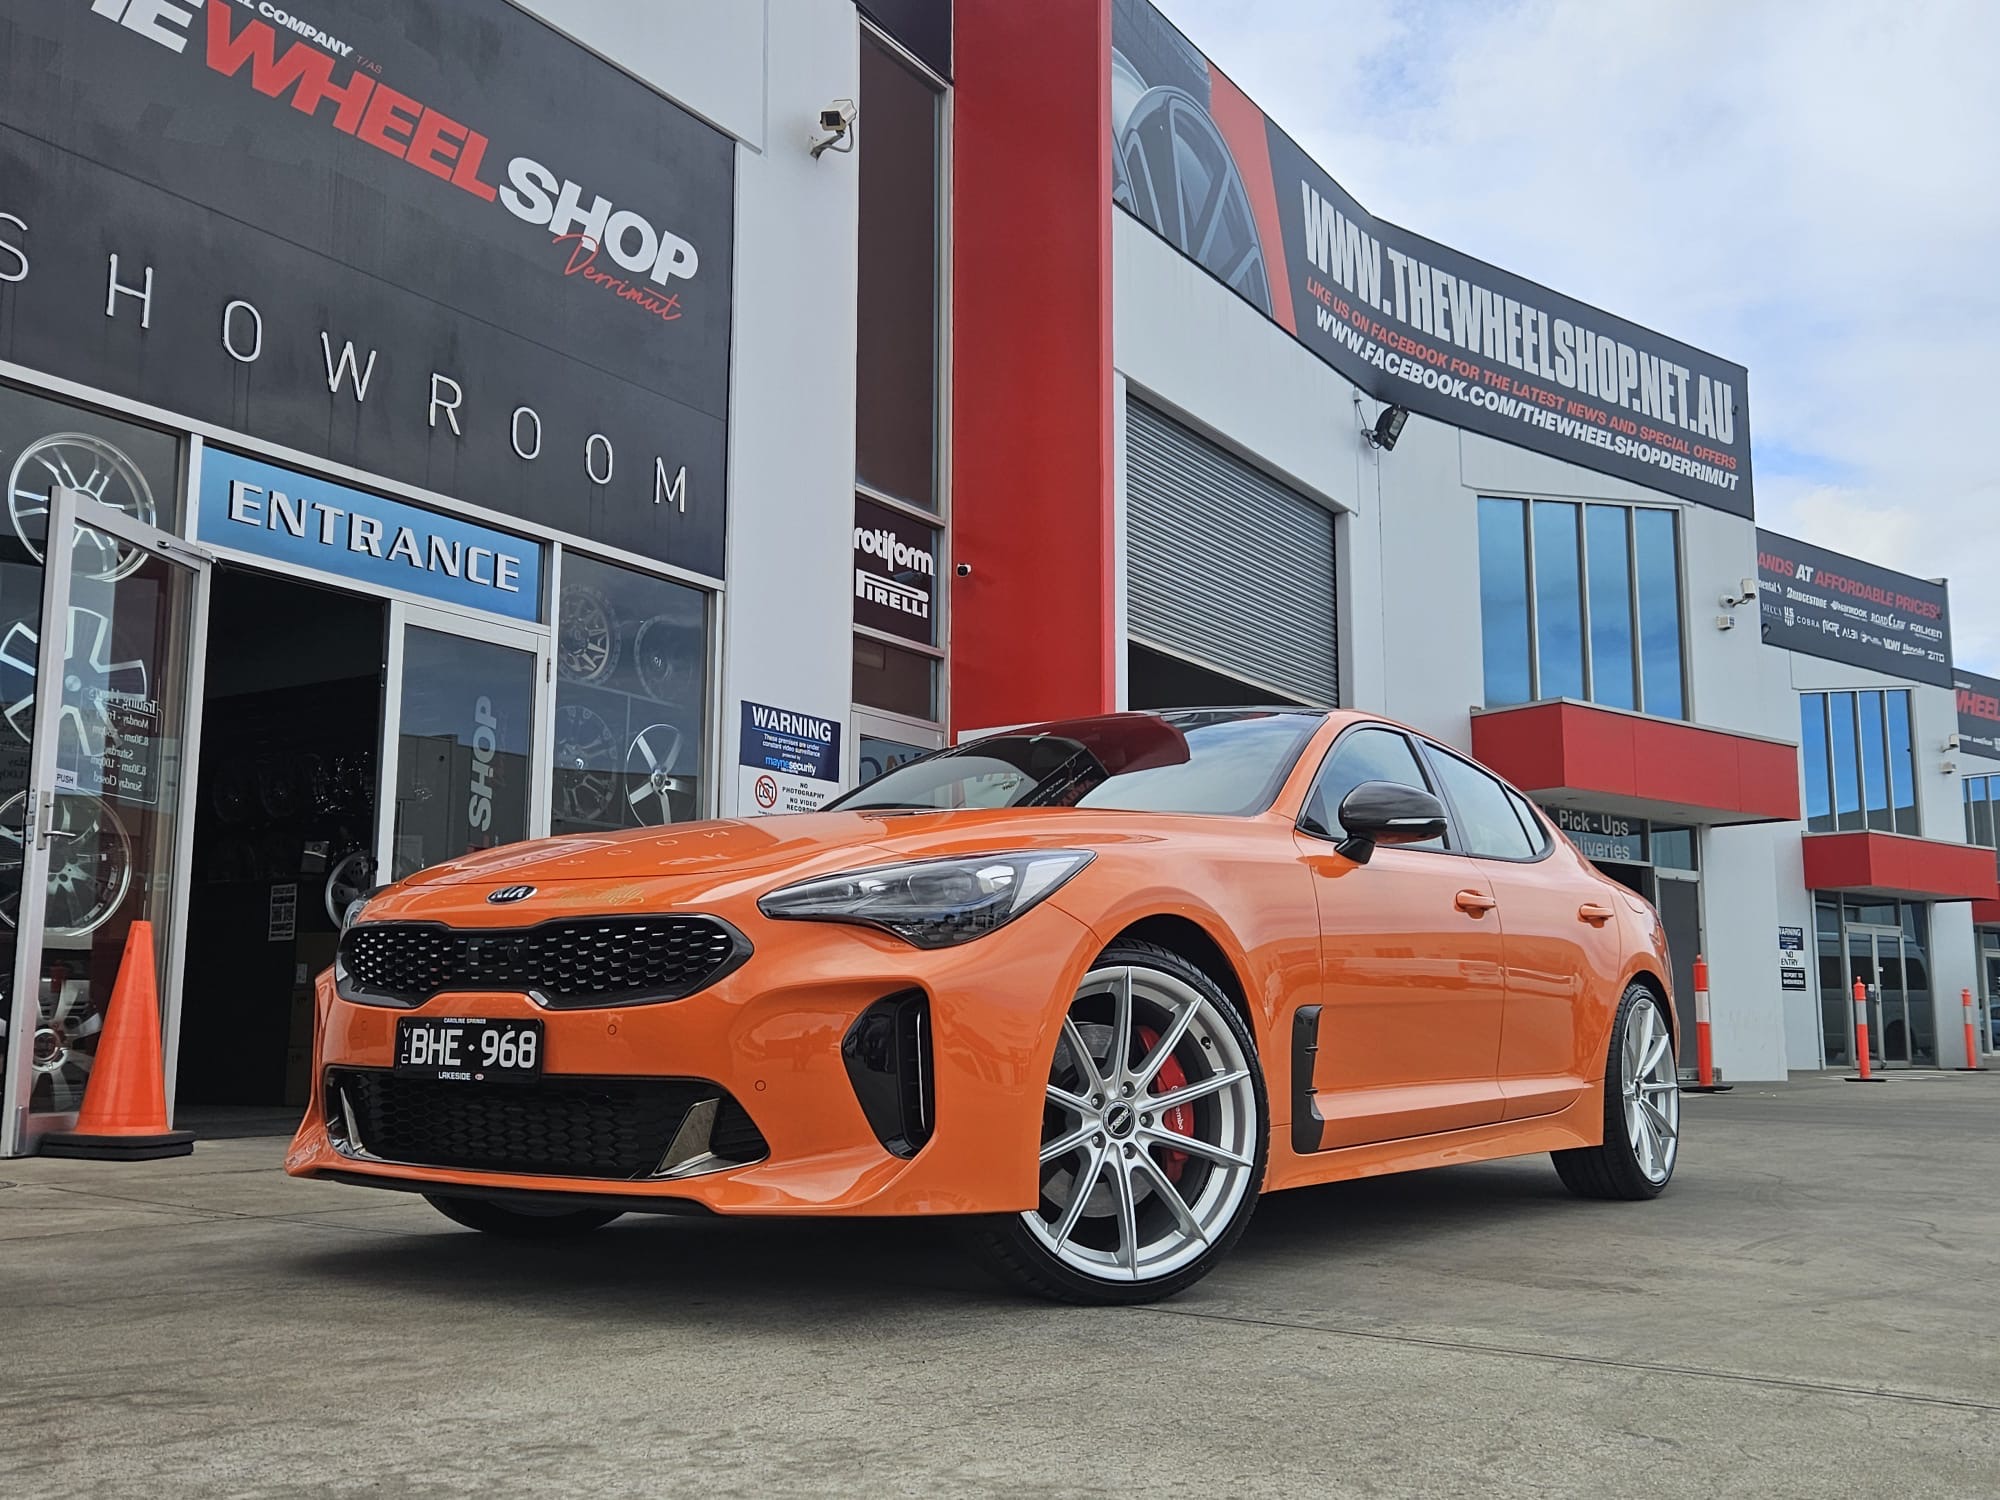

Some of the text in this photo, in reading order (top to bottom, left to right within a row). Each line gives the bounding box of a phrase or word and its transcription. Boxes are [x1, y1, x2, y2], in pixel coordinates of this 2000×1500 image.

[258, 1, 382, 75] COMPANY T/AS
[206, 0, 497, 203] WHEEL
[500, 157, 699, 286] SHOP
[552, 233, 682, 320] Derrimut
[1301, 179, 1734, 446] WWW.THEWHEELSHOP.NET.AU
[1307, 276, 1737, 470] LIKE US ON FACEBOOK FOR THE LATEST NEWS AND SPECIAL OFFERS
[1316, 304, 1739, 491] WWW.FACEBOOK.COM/THEWHEELSHOPDERRIMUT
[228, 479, 521, 594] ENTRANCE
[853, 527, 934, 576] rotiform
[856, 568, 929, 619] PIRELLI
[1786, 586, 1827, 609] BRIDGESTONE
[1795, 563, 1814, 583] AT
[1815, 570, 1893, 608] AFFORDABLE
[752, 705, 832, 743] WARNING
[764, 733, 778, 743] These
[468, 695, 499, 831] SHOP
[782, 743, 795, 752] video
[56, 773, 74, 784] PUSH
[782, 787, 825, 800] PHOTOGRAPHY
[800, 799, 817, 808] VIDEO
[1559, 809, 1590, 832] Pick
[1601, 814, 1629, 838] Ups
[1781, 958, 1798, 966] ENTRY
[410, 1028, 537, 1068] BHE 968
[438, 1071, 471, 1080] LAKESIDE
